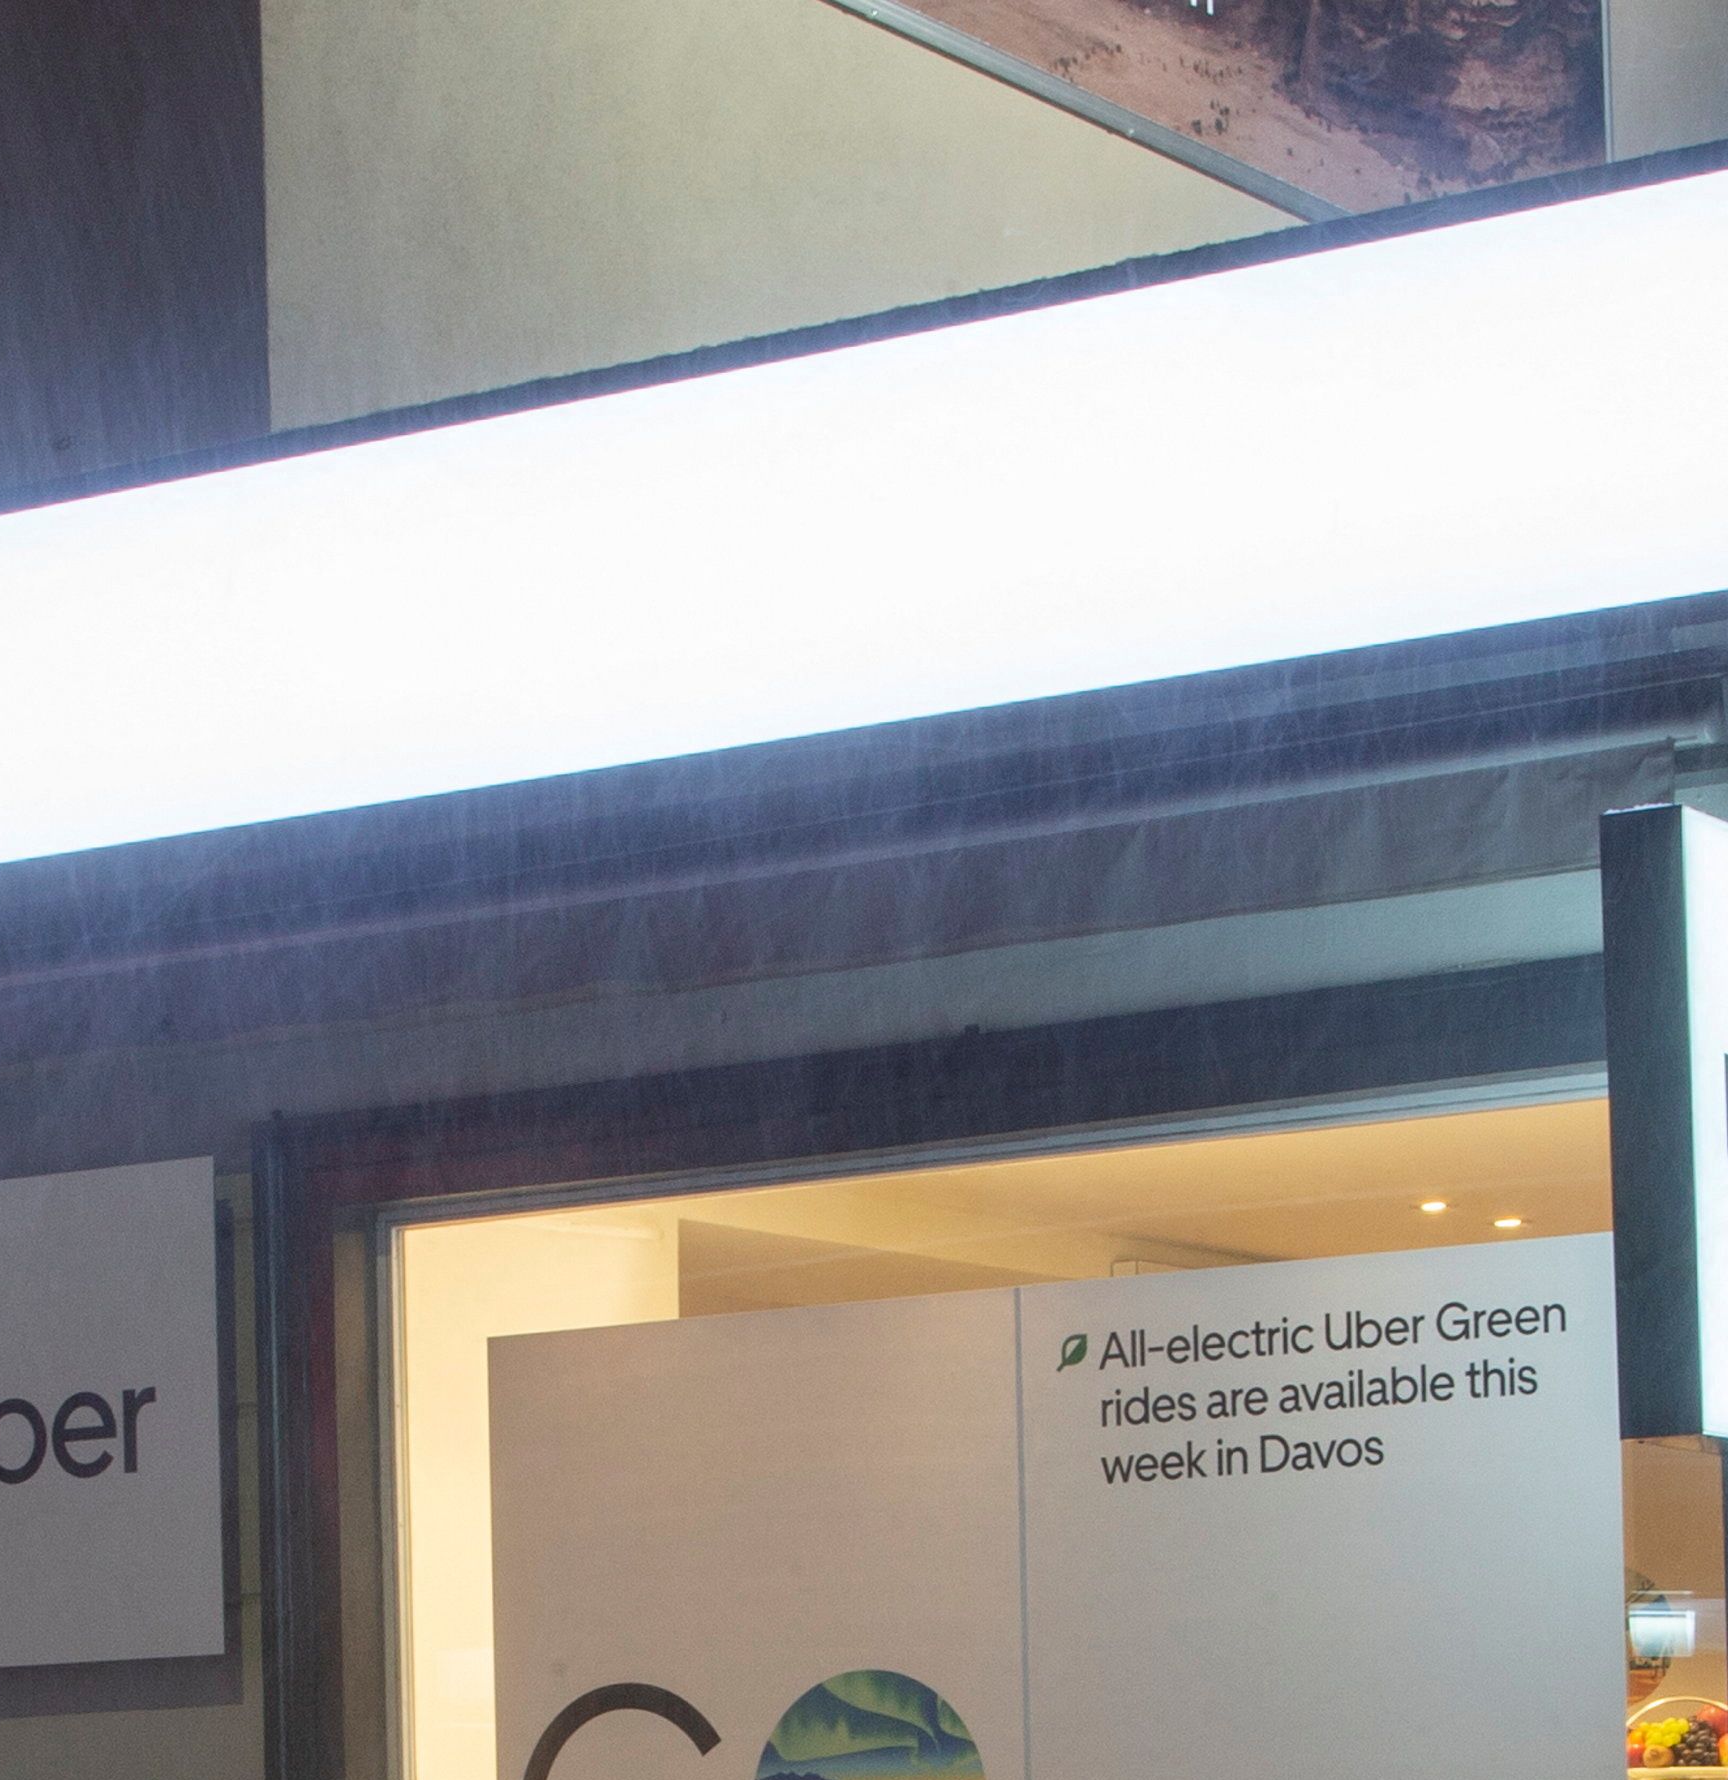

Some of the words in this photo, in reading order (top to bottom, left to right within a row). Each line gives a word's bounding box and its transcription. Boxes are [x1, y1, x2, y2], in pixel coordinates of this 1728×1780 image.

[1099, 1316, 1315, 1371] All-electric
[1324, 1309, 1425, 1352] Uber
[1435, 1301, 1567, 1342] Green
[1100, 1386, 1197, 1428] rides
[1206, 1386, 1269, 1420] are
[1279, 1363, 1456, 1414] available
[1465, 1357, 1538, 1400] this
[1100, 1441, 1208, 1485] week
[1217, 1437, 1249, 1477] in
[1259, 1434, 1385, 1474] Davos
